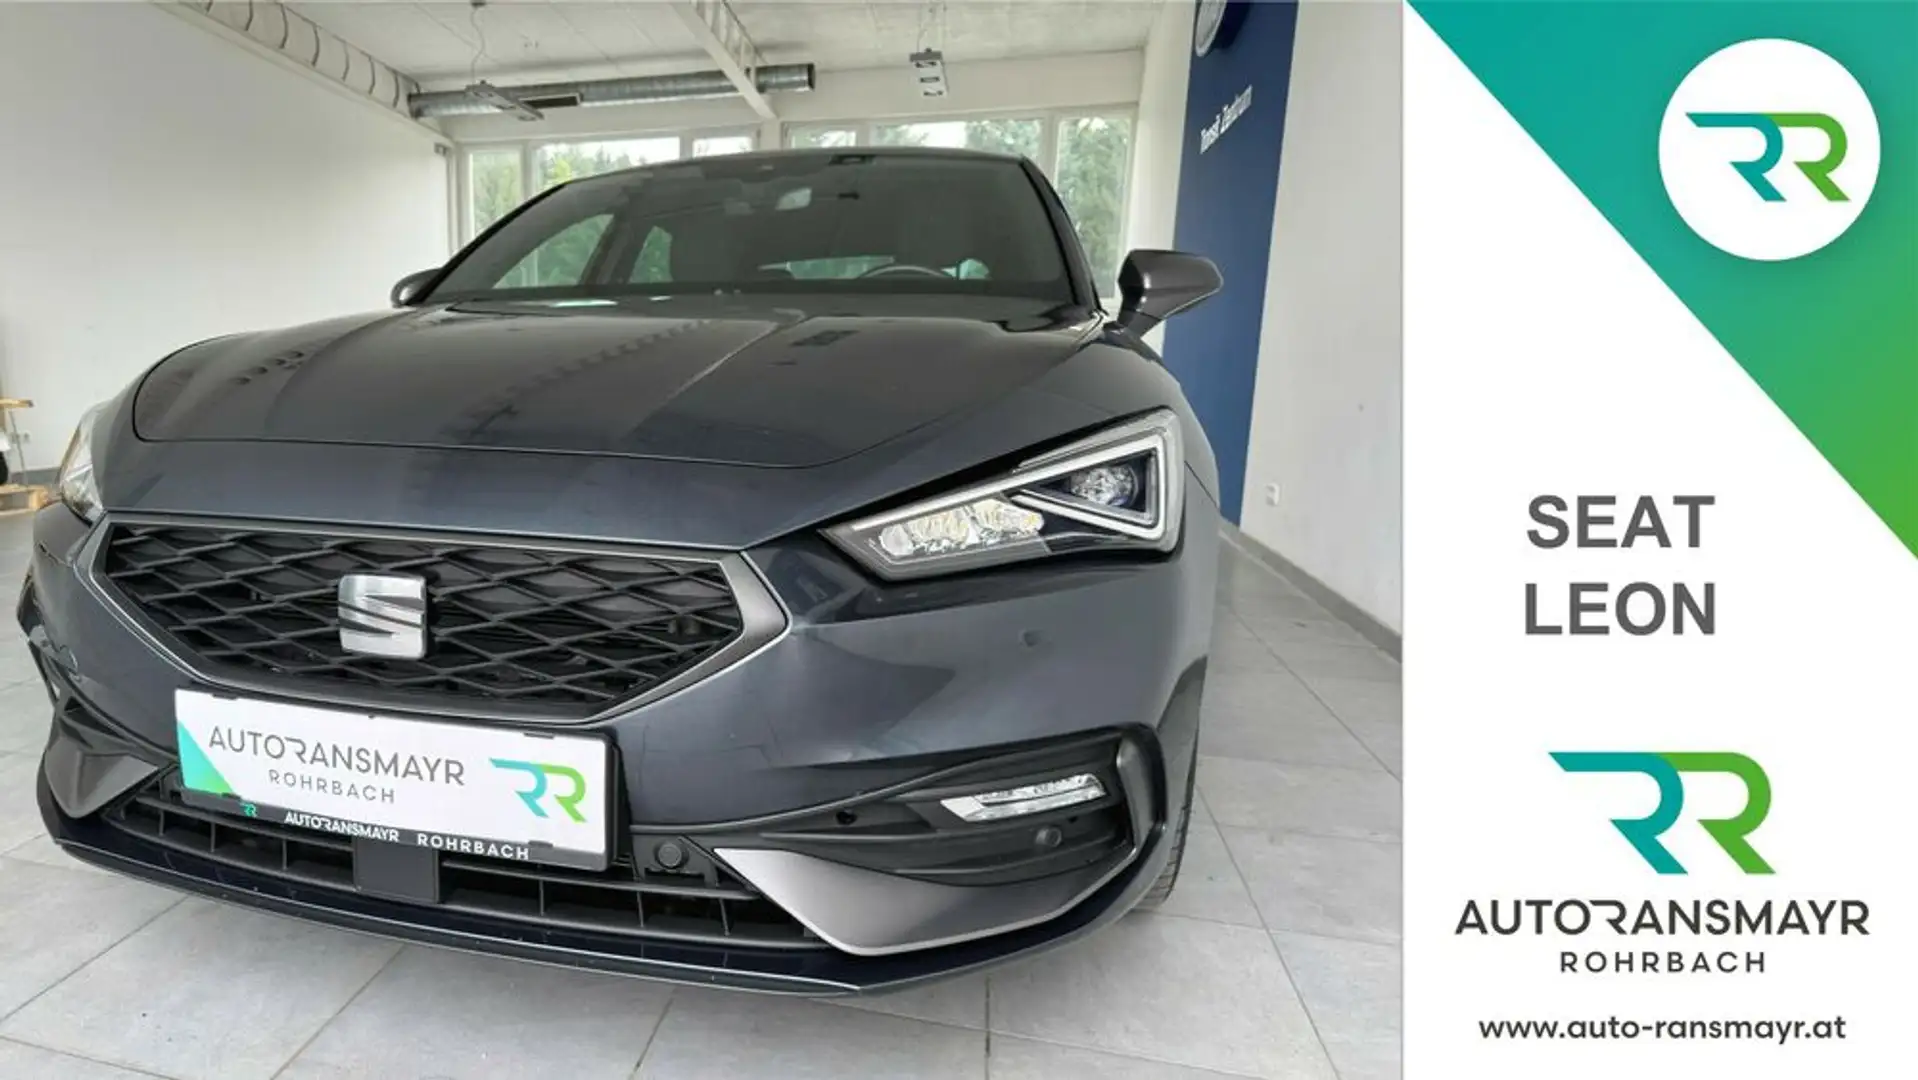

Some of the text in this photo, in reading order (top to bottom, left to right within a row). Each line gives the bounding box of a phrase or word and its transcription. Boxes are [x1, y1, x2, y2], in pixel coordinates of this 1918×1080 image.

[208, 724, 466, 786] AUTORANSMAYR
[268, 768, 396, 804] ROHRBACH
[284, 810, 531, 861] AUTORANSMAYR ROHRBACH
